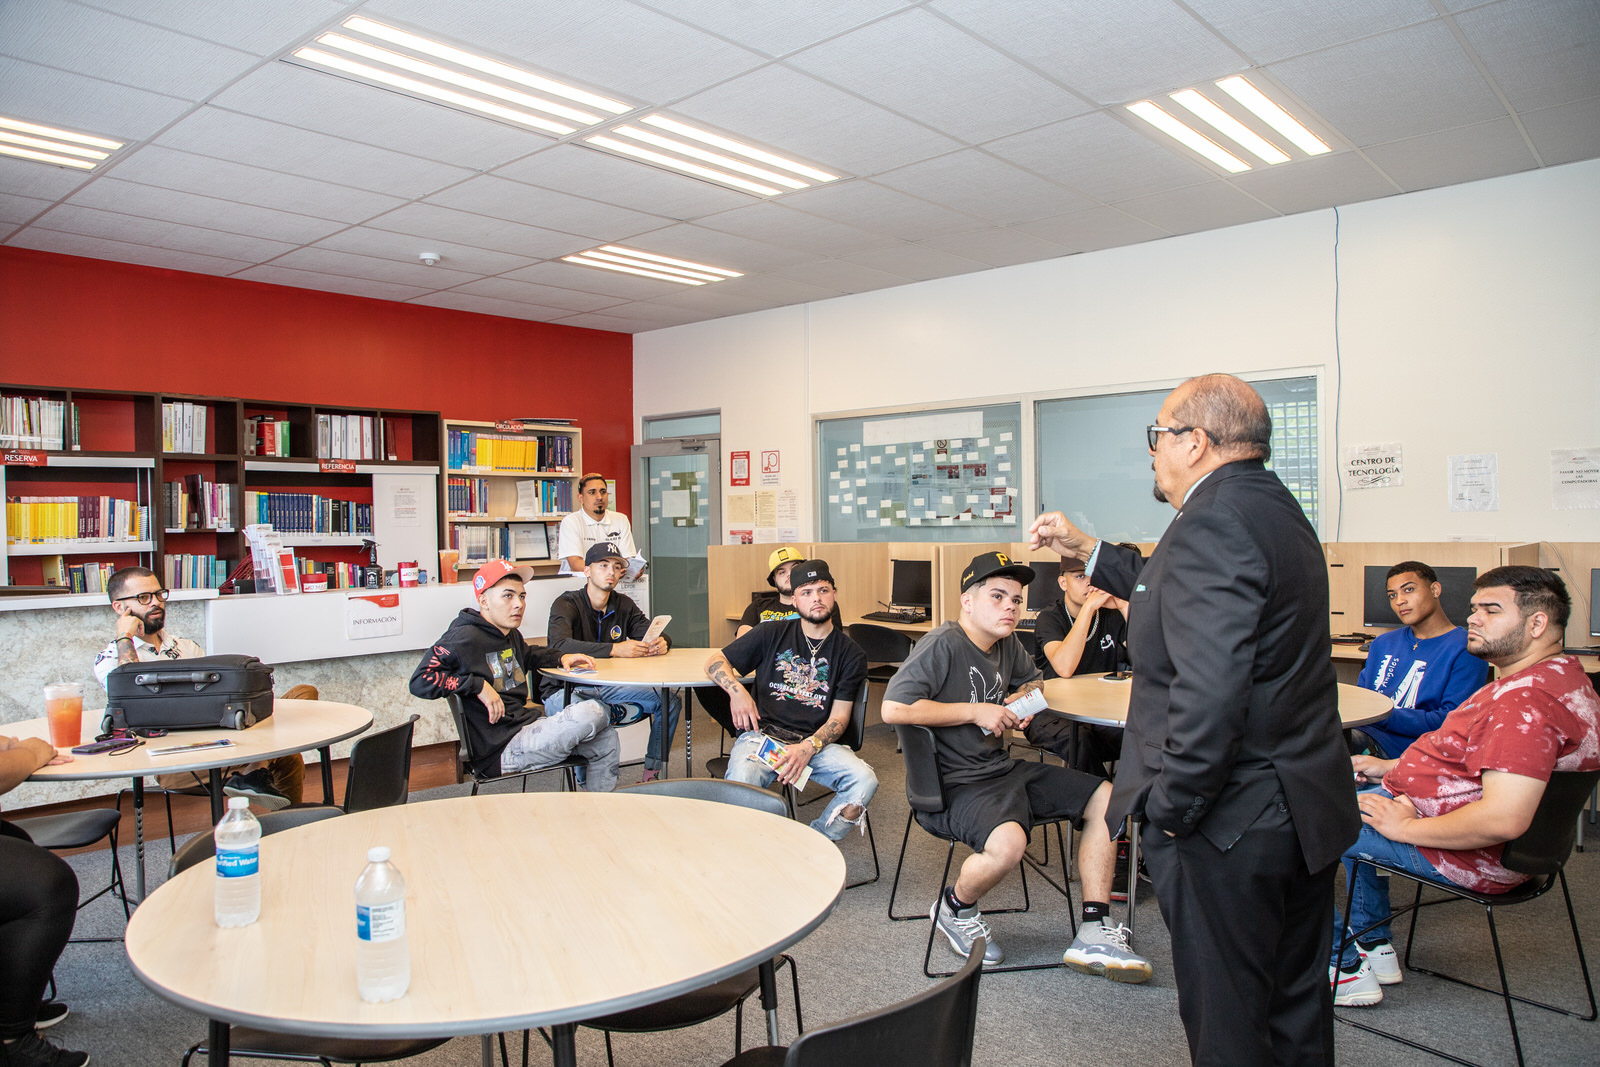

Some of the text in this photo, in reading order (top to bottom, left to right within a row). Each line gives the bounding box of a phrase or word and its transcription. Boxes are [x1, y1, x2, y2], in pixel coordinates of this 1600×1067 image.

[4, 454, 38, 462] RESERVA
[1351, 456, 1396, 466] CENTRO DE
[1348, 465, 1400, 477] TECNOLOGÍA
[607, 543, 618, 554] NY
[995, 553, 1009, 566] P
[500, 560, 514, 572] LA
[352, 616, 397, 626] INFORMACIÓN
[238, 857, 258, 866] Water
